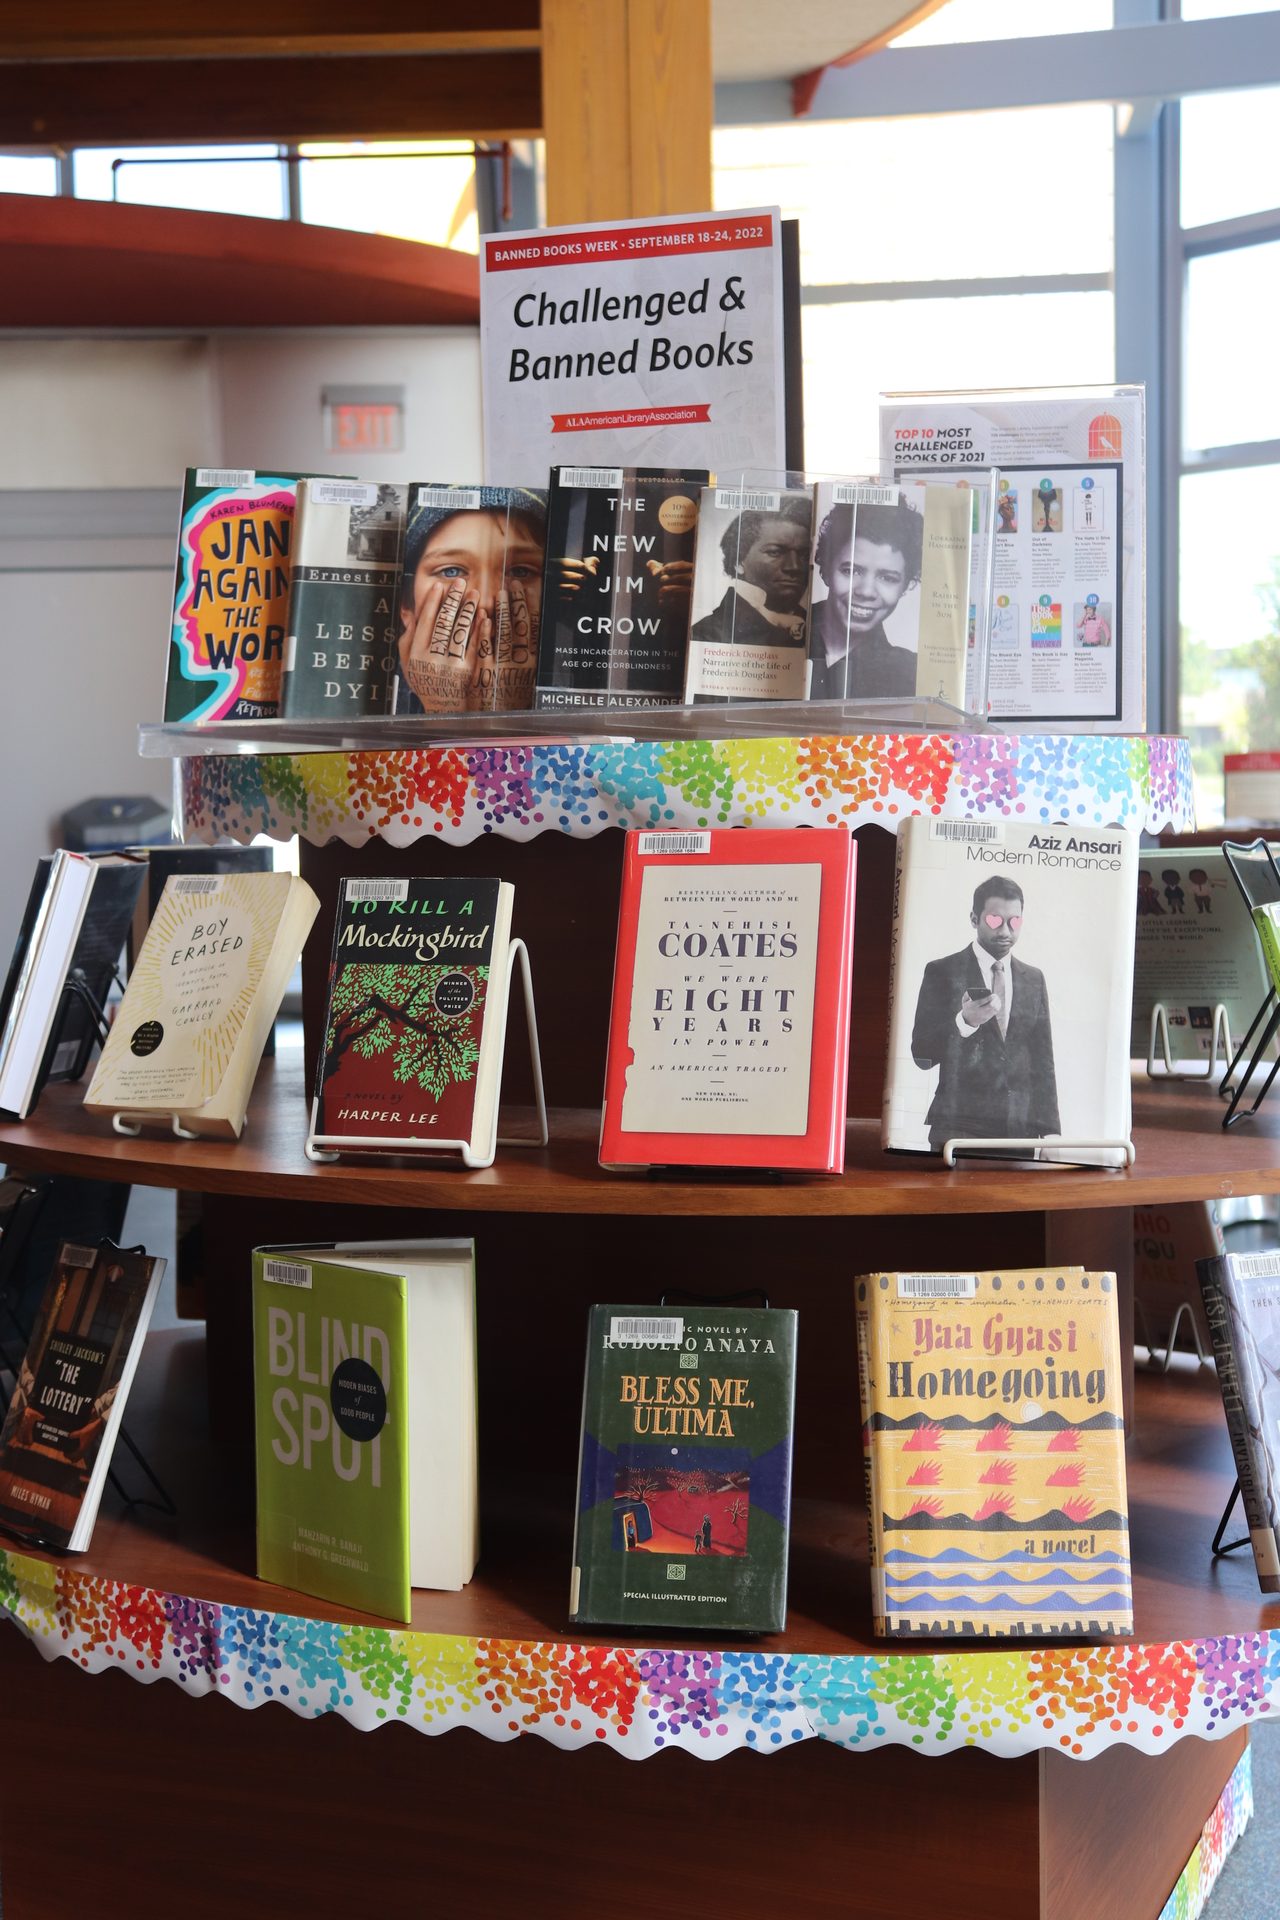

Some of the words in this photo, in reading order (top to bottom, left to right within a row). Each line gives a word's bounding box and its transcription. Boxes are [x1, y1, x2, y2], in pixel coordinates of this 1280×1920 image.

[495, 248, 540, 262] BANNED
[544, 244, 582, 257] BOOKS
[585, 240, 618, 252] WEEK
[628, 234, 694, 249] SEPTEMBER
[698, 230, 732, 243] 18-24,
[735, 227, 764, 240] 2022
[514, 278, 710, 328] Challenged
[719, 276, 746, 312] &
[508, 338, 640, 382] Banned
[650, 331, 754, 372] Books
[894, 429, 918, 439] TOP
[921, 428, 934, 438] 10
[936, 428, 972, 438] MOST
[894, 440, 973, 452] CHALLENGED
[894, 454, 937, 464] BOOKS
[940, 453, 957, 462] OF
[960, 452, 985, 462] 2021
[210, 505, 244, 519] KAREN
[608, 498, 646, 512] THE
[211, 519, 290, 565] JAN
[592, 534, 656, 552] NEW
[309, 570, 371, 582] Ernest
[598, 576, 644, 594] JIM
[374, 598, 390, 613] A
[223, 606, 262, 628] THE
[577, 616, 661, 636] CROW
[316, 623, 396, 642] LESS
[448, 600, 476, 662] LOUD
[581, 648, 648, 657] INCARCERATION
[704, 648, 740, 658] Frederick
[742, 650, 778, 660] Douglass
[312, 652, 396, 672] BEFO
[408, 658, 436, 674] AUTHOR
[596, 661, 672, 670] COLORBLINDNESS
[704, 658, 740, 667] Narrative
[752, 661, 766, 669] the
[766, 662, 780, 670] Life
[782, 662, 792, 670] of
[702, 668, 739, 678] Frederick
[742, 670, 777, 680] Douglass
[542, 694, 604, 706] MICHELLE
[1028, 834, 1062, 850] Aziz
[1065, 837, 1122, 856] Ansari
[966, 846, 1034, 866] Modern
[1037, 850, 1122, 872] Romance
[351, 900, 378, 914] TO
[388, 900, 449, 914] KILL
[458, 900, 474, 914] A
[192, 917, 229, 942] BOY
[668, 921, 791, 930] TA-NEHISI
[170, 936, 244, 966] ERASED
[338, 924, 490, 962] Mockingbird
[658, 932, 798, 958] COATES
[684, 975, 704, 983] WE
[720, 975, 770, 984] WERE
[654, 988, 795, 1012] EIGHT
[652, 1016, 793, 1033] YEARS
[673, 1038, 692, 1046] IN
[706, 1038, 770, 1047] POWER
[338, 1109, 402, 1122] HARPER
[408, 1113, 439, 1124] LEE
[1202, 1284, 1227, 1330] LISA
[1252, 1298, 1272, 1308] THEN
[913, 1318, 974, 1357] Yaa
[983, 1312, 1078, 1357] Gyasi
[268, 1306, 390, 1397] BLIND
[704, 1338, 776, 1354] ANAYA
[56, 1359, 80, 1384] "THE
[886, 1356, 1105, 1404] Homegoing
[1213, 1338, 1243, 1412] JEWELL
[338, 1379, 356, 1390] HIDDEN
[358, 1384, 376, 1394] BIASES
[620, 1376, 700, 1405] BLESS
[708, 1378, 754, 1408] ME,
[40, 1386, 92, 1415] LOTTERY"
[340, 1407, 354, 1418] GOOD
[356, 1410, 375, 1422] PEOPLE
[634, 1405, 734, 1437] ULTIMA
[11, 1486, 29, 1502] MILES
[30, 1492, 52, 1510] HYMAN
[1024, 1538, 1036, 1554] a
[1042, 1534, 1096, 1554] novel
[651, 1594, 697, 1602] ILLUSTRATED
